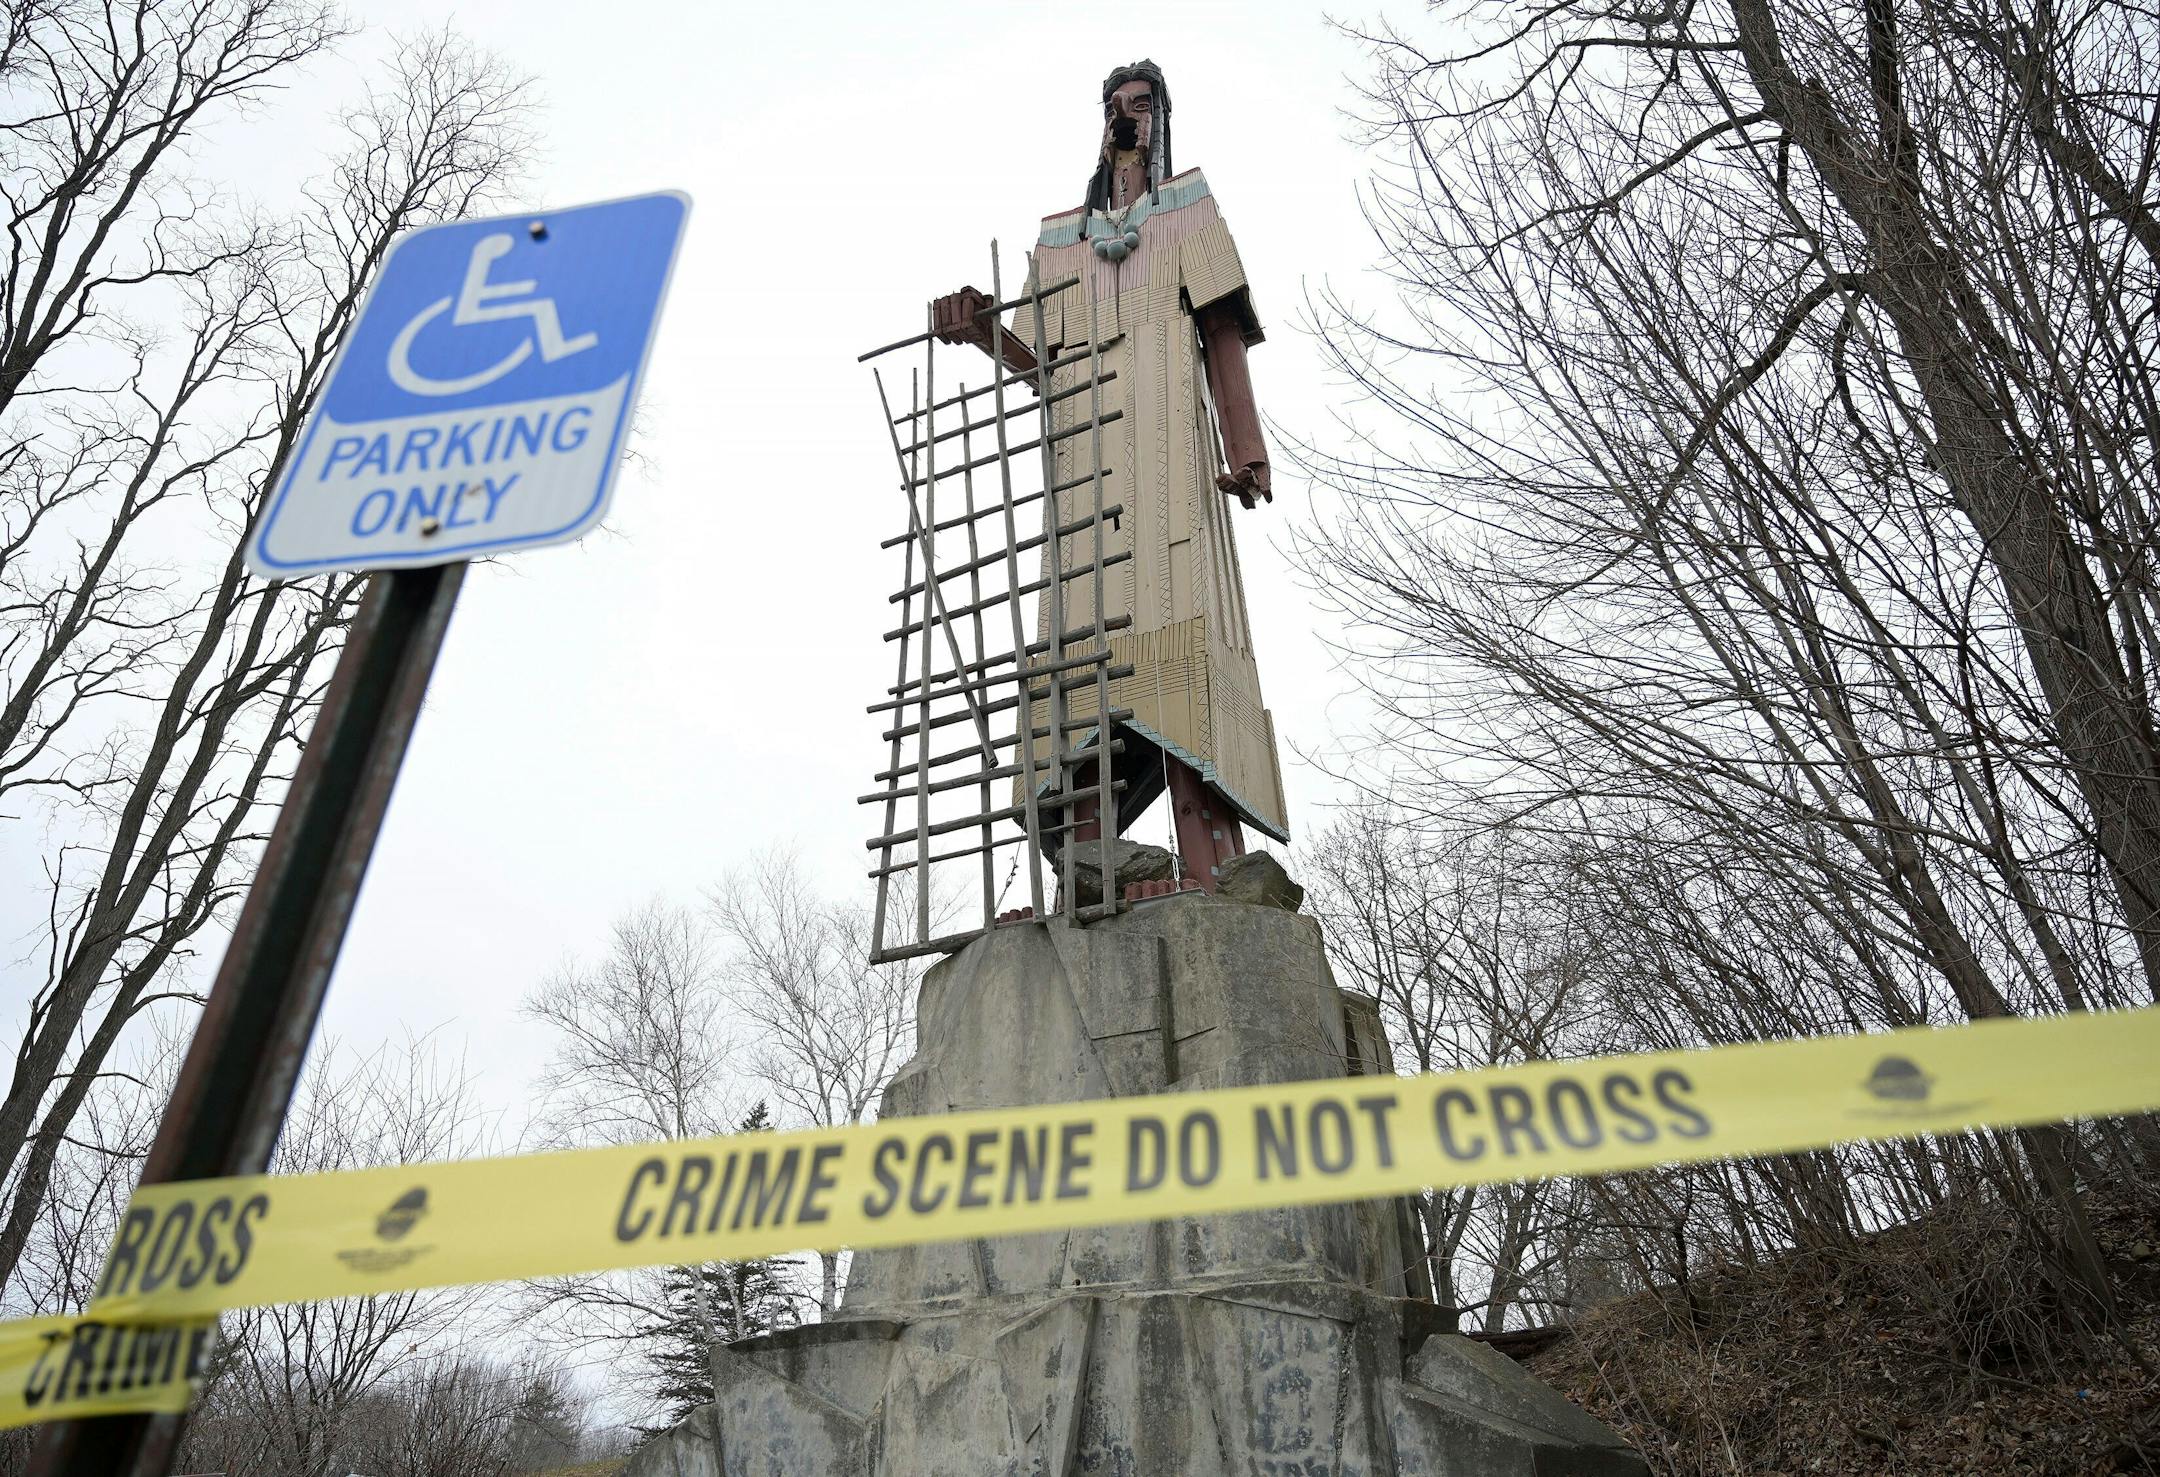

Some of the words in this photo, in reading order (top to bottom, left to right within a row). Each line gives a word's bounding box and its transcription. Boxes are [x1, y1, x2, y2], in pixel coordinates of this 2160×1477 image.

[319, 405, 592, 482] PARKING
[351, 474, 521, 537] ONLY
[615, 1142, 845, 1244] CRIME
[863, 1121, 1094, 1220] SCENE
[1125, 1109, 1221, 1193] DO
[1255, 1094, 1398, 1182] NOT
[1432, 1067, 1714, 1163] CROSS
